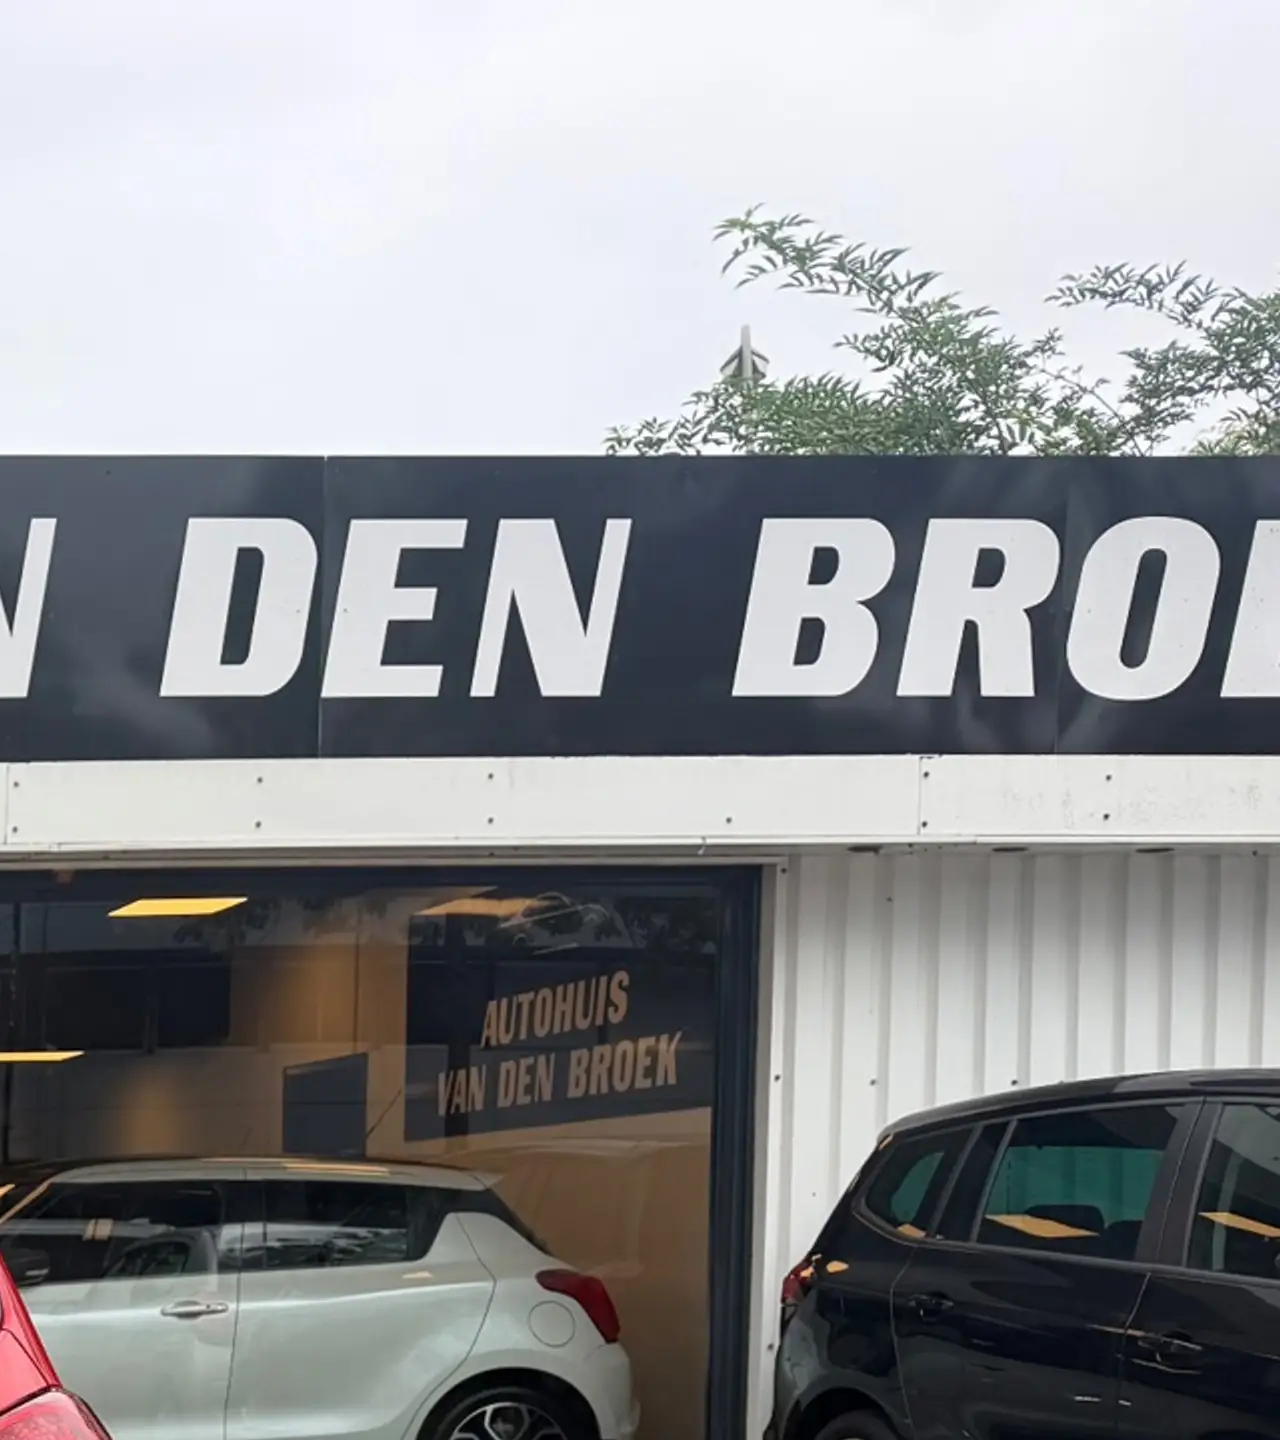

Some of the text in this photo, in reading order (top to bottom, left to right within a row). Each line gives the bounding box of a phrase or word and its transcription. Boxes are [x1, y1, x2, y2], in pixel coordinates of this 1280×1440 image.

[159, 517, 633, 698] DEN
[480, 970, 630, 1048] AUTOHUIS
[437, 1031, 683, 1117] VAN DEN BROEK
